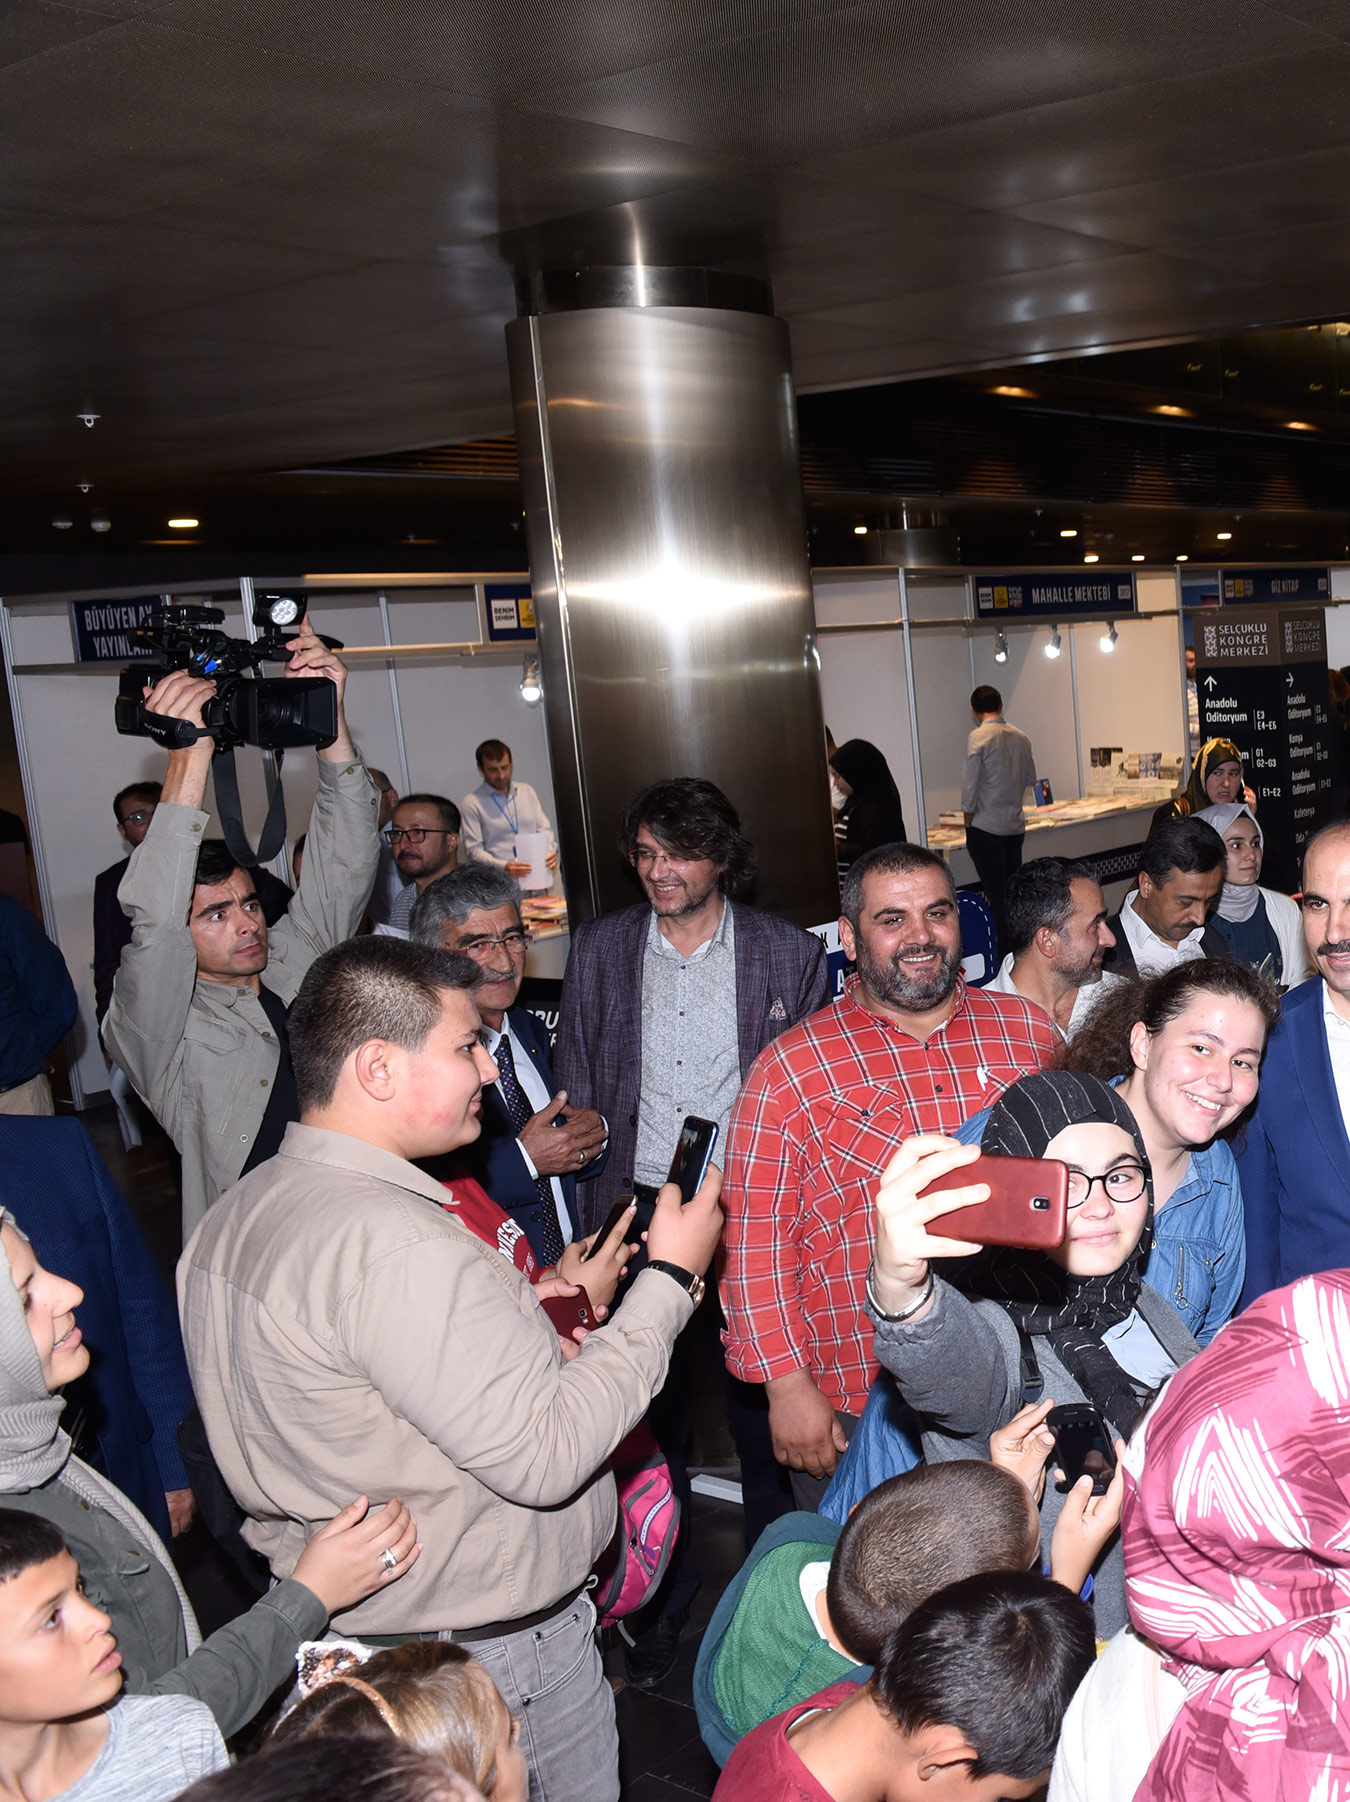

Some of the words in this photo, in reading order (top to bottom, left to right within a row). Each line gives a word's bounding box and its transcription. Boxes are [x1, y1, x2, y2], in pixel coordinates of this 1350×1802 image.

[1032, 586, 1074, 604] MAHALLE
[1074, 583, 1111, 603] MEKTEBİ
[84, 604, 137, 631] BÜYÜYEN
[1218, 623, 1267, 635] SELÇUKLU
[1219, 634, 1268, 646] KONGRE
[1220, 644, 1269, 657] MERKEZİ
[1205, 697, 1238, 709] Anadolu
[1287, 692, 1306, 706] Anadolu
[1206, 711, 1248, 724] Oditoryum
[1256, 710, 1265, 720] E3
[1287, 708, 1312, 720] Oditoryum
[1257, 720, 1277, 731] E4-E5
[1255, 748, 1264, 757] G1
[1256, 758, 1277, 768] G2-G3
[1262, 787, 1281, 797] E1-E2
